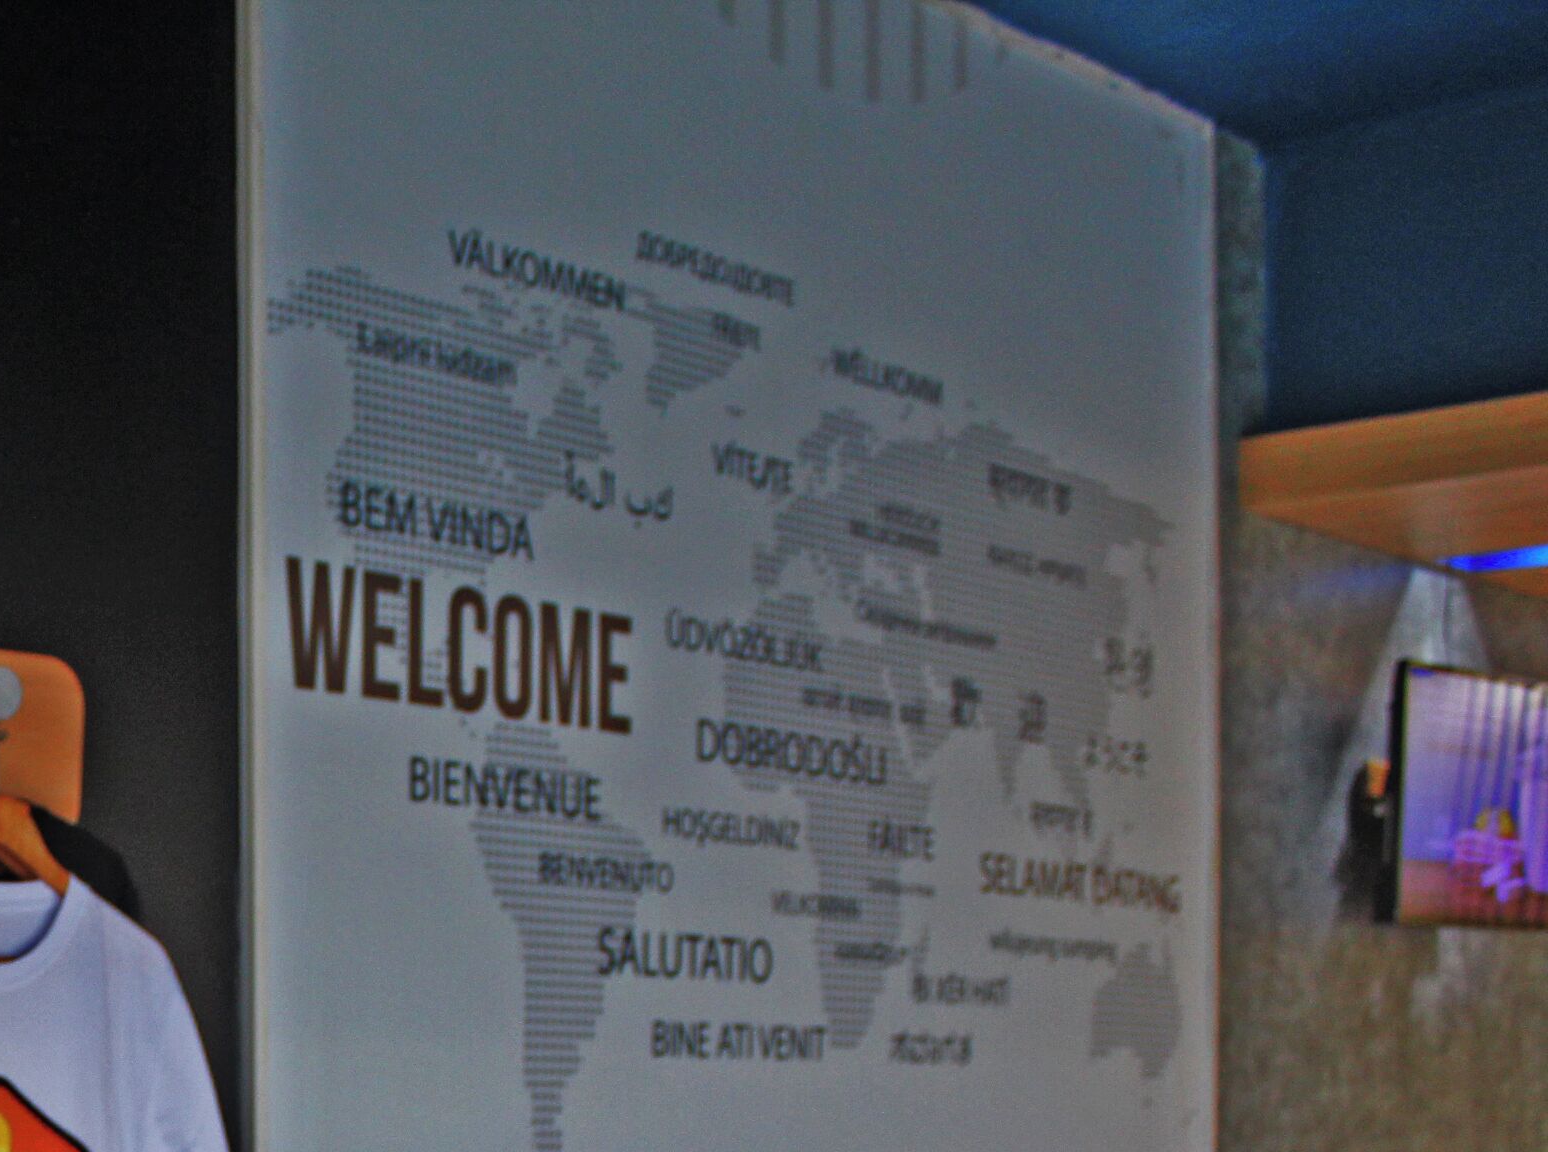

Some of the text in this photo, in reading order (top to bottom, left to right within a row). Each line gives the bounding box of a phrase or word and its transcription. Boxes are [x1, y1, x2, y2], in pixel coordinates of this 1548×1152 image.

[339, 479, 535, 562] BEM VINDA
[285, 556, 633, 735] WELCOME
[408, 754, 603, 822] BIENVENUE
[978, 852, 1087, 904] SELAMAT
[597, 925, 774, 985] SALUTATIO
[651, 1018, 710, 1059] BINE
[757, 1022, 827, 1062] VENIT
